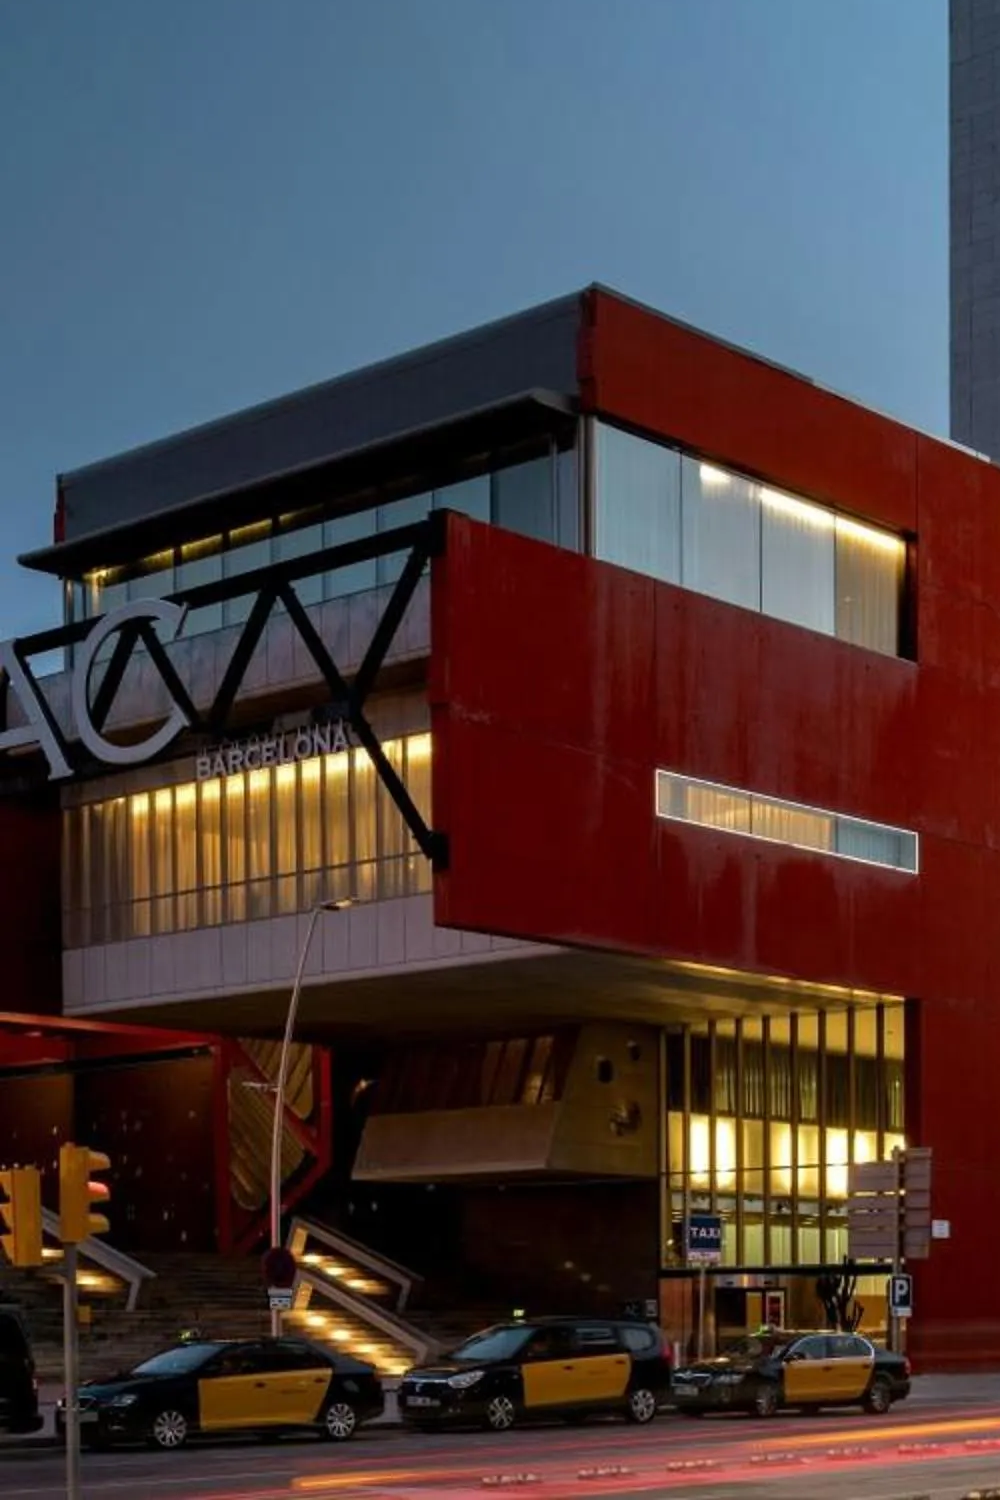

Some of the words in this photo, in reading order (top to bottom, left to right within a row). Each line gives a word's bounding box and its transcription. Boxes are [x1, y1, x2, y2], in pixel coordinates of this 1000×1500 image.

[0, 598, 190, 781] AC
[196, 728, 348, 782] BARCELONA
[690, 1227, 720, 1237] TAXI
[895, 1279, 909, 1303] P
